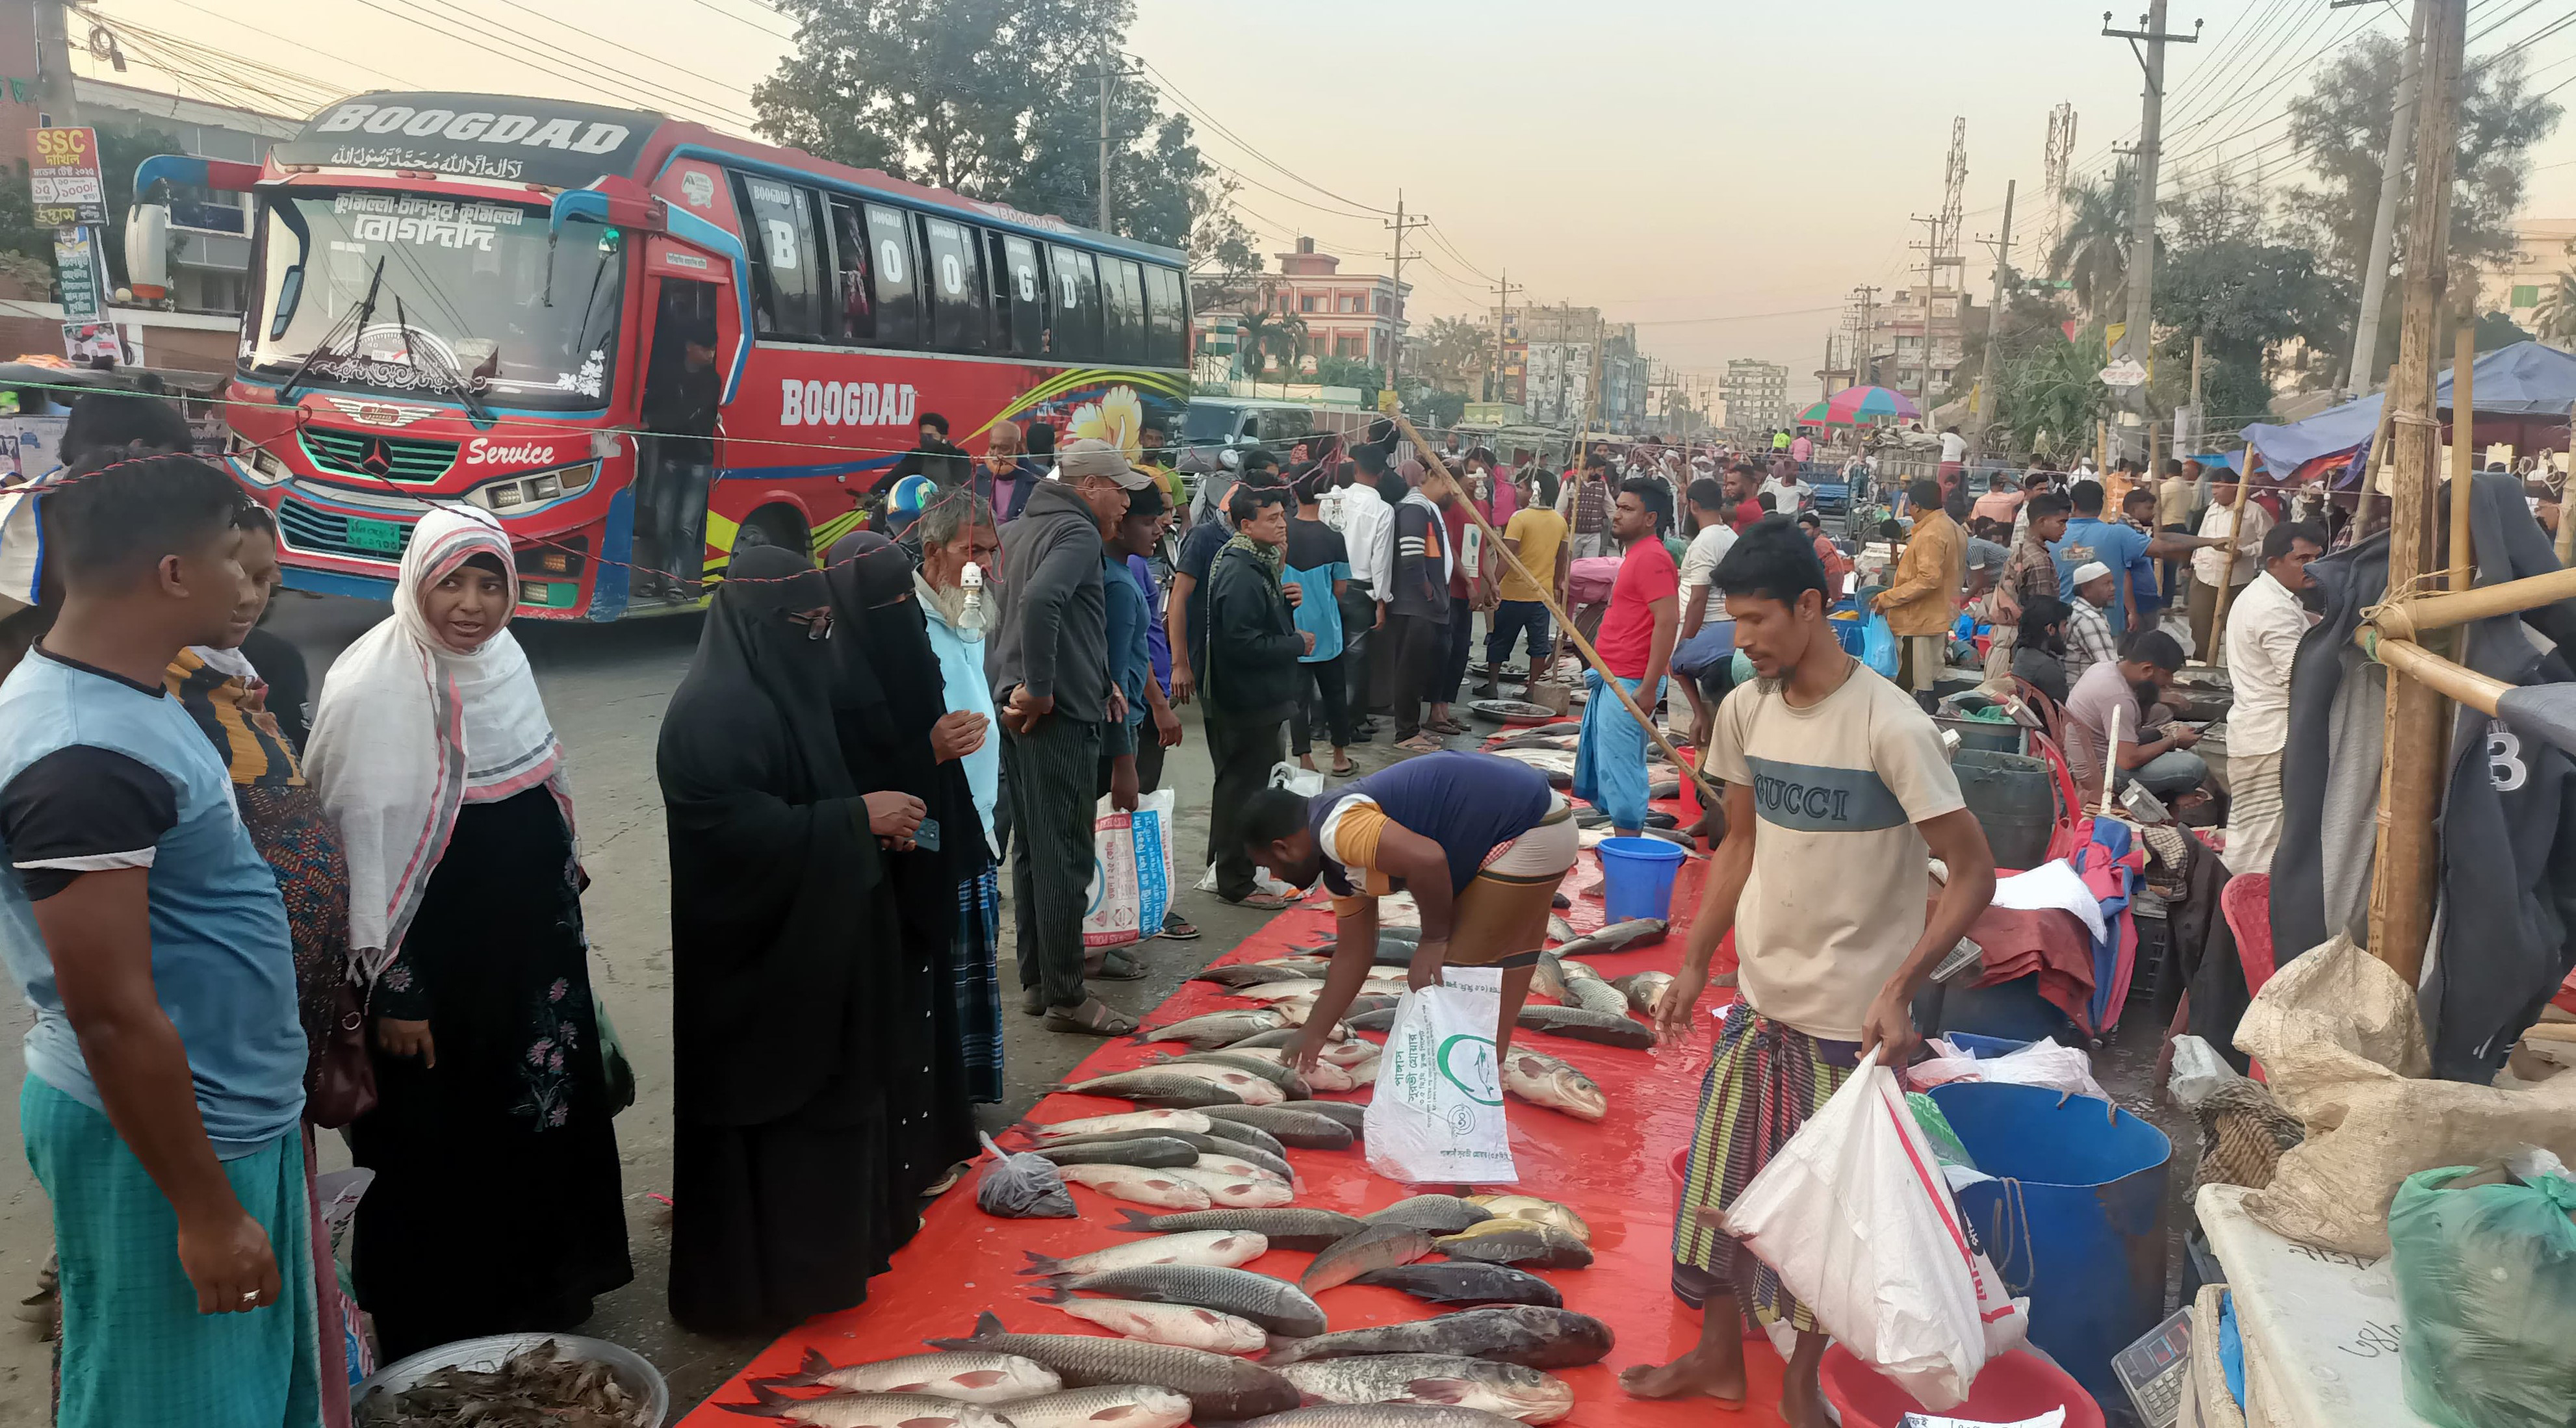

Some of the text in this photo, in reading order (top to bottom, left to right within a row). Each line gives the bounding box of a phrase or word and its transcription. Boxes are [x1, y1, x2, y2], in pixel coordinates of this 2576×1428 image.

[36, 129, 85, 154] SSC
[316, 104, 630, 155] BOOGDAD
[45, 151, 80, 166] দাখিল
[753, 186, 790, 205] BOOGDAD
[353, 214, 496, 251] বোগদাদ
[872, 210, 901, 228] BOOGDAD
[999, 206, 1058, 233] BOOGDAD
[768, 219, 797, 269] B
[1017, 264, 1035, 302] G
[1062, 274, 1077, 309] D
[780, 378, 916, 426] BOOGDAD
[466, 437, 555, 466] Service
[1753, 774, 1849, 821] GUCCI
